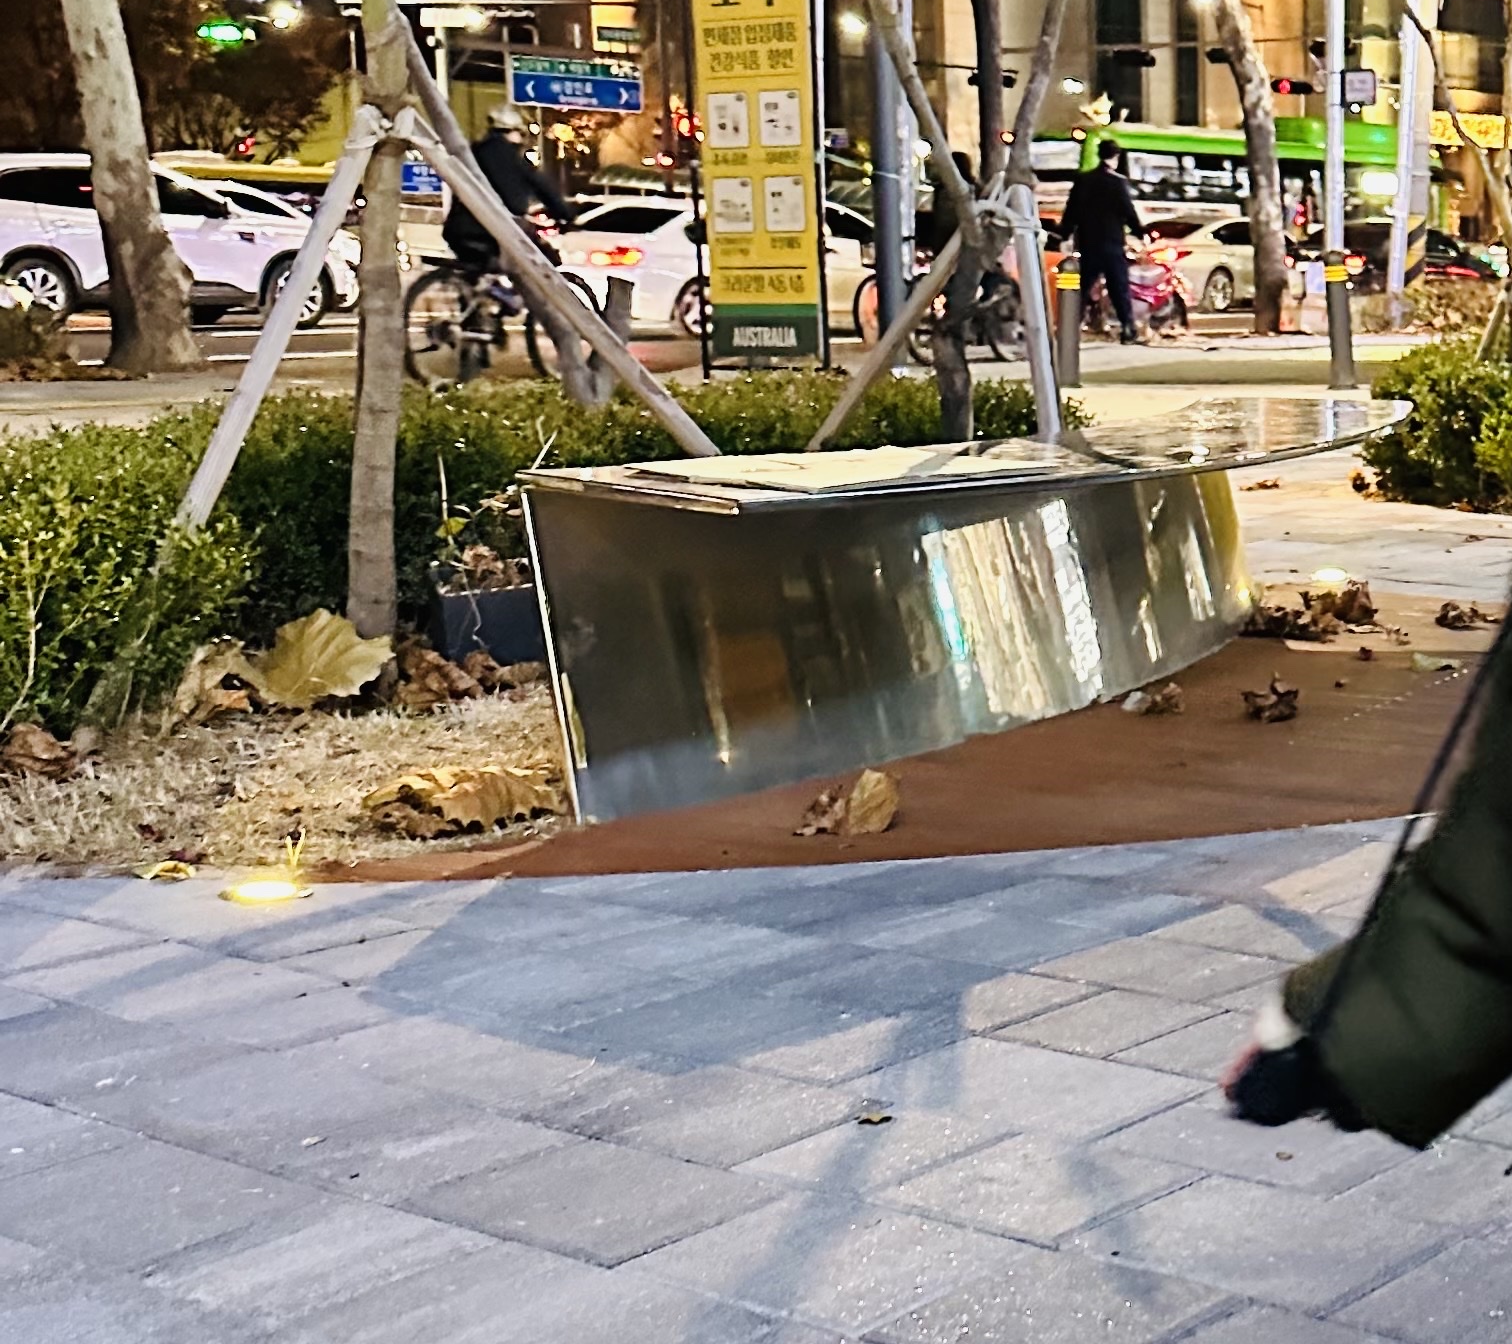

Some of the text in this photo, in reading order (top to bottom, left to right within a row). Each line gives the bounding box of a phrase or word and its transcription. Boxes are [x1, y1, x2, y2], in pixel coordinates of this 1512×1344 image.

[710, 47, 794, 72] 건강식품 할인
[733, 326, 798, 347] AUSTRALIA
